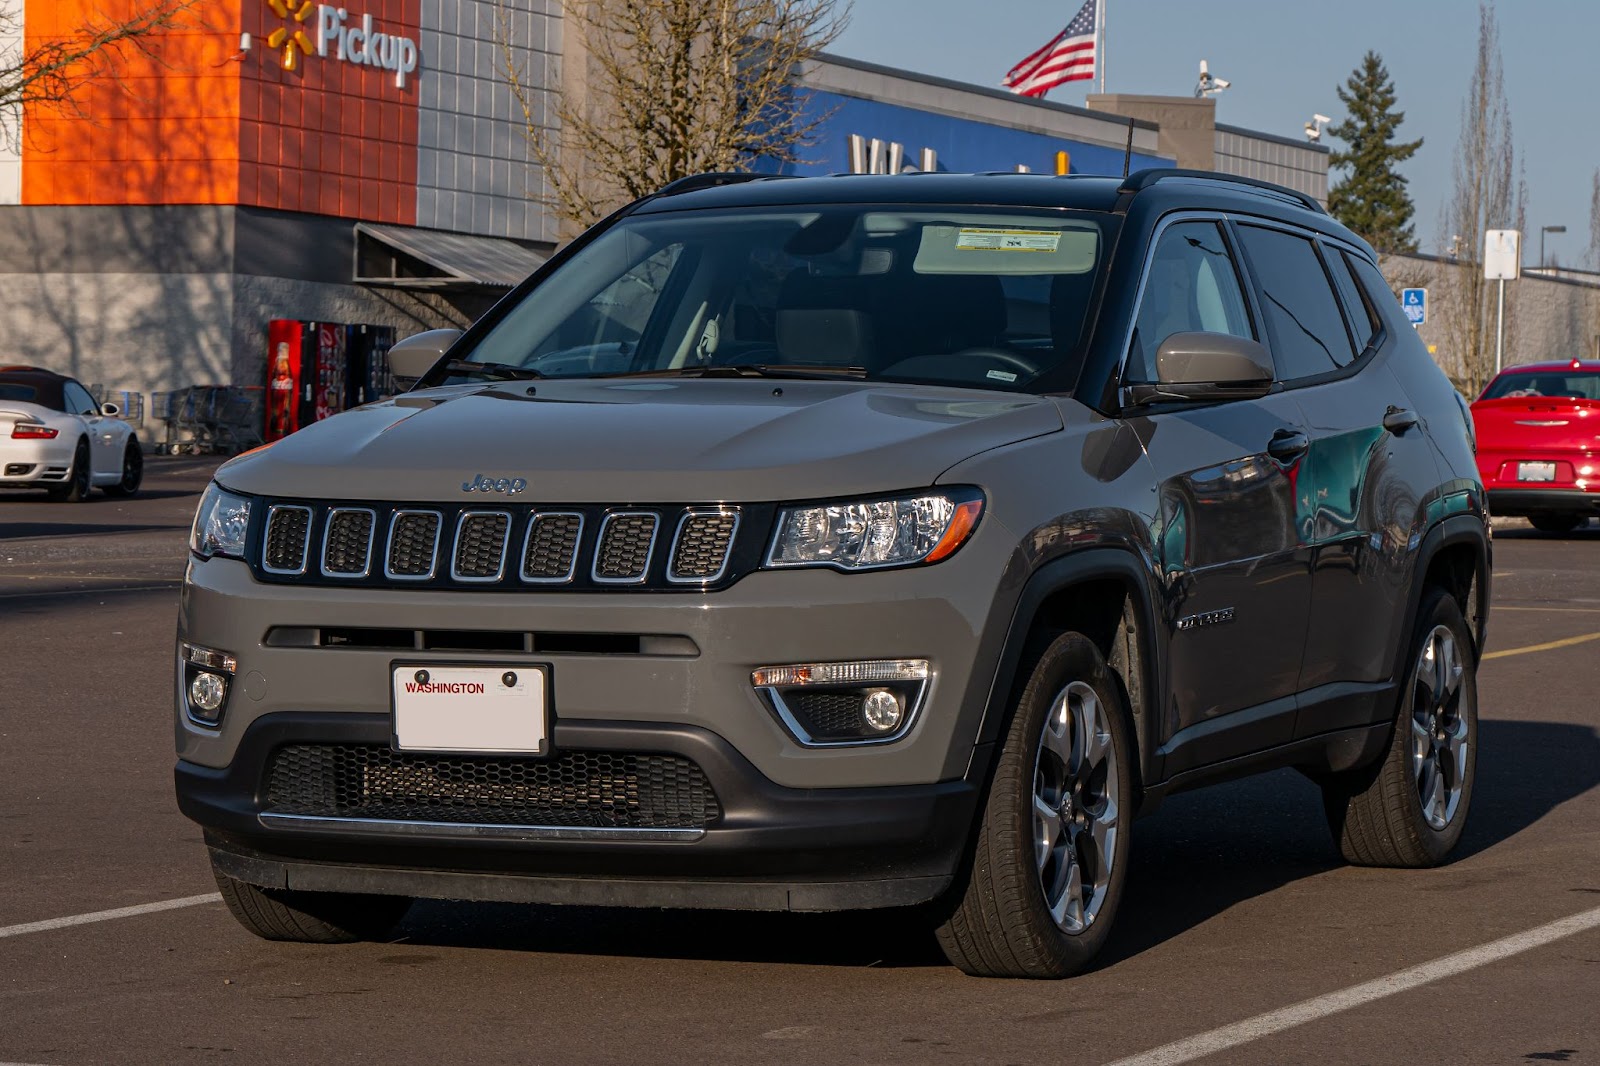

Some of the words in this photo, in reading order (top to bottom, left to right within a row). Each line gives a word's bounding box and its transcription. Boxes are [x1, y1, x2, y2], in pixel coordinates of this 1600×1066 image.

[318, 4, 417, 88] Pickup
[462, 474, 528, 496] Jeep
[405, 682, 484, 694] WASHINGTON
